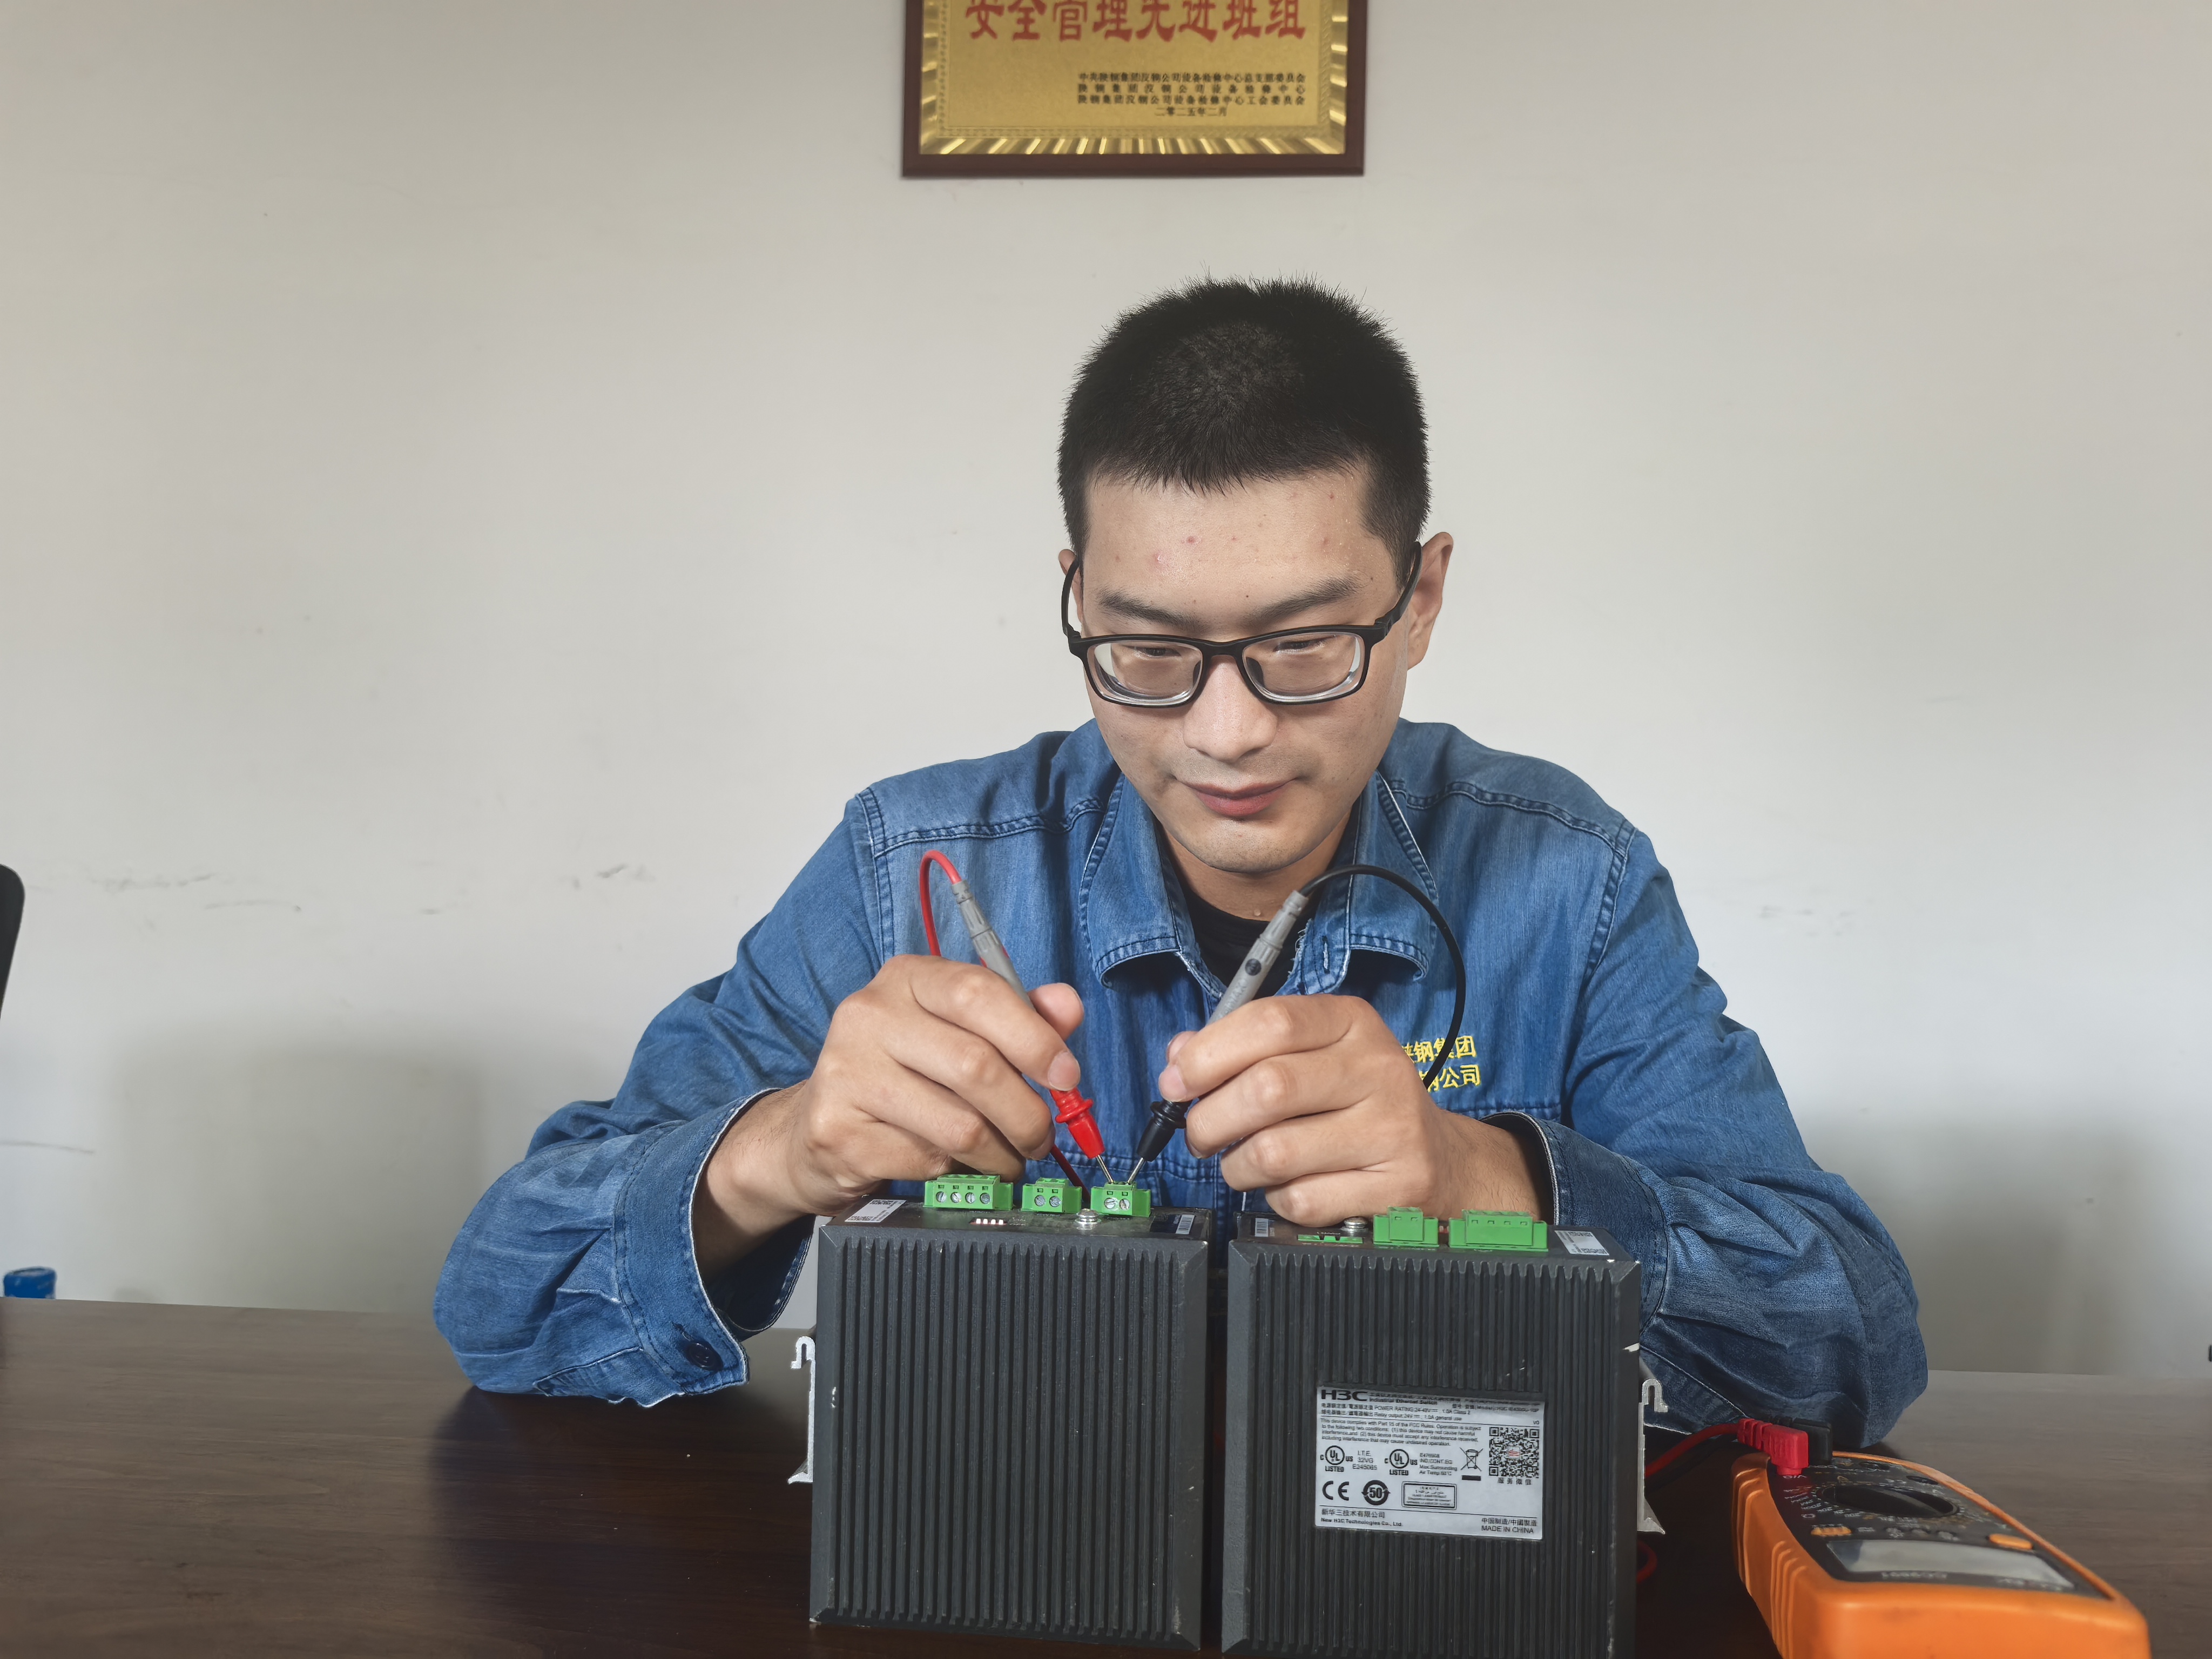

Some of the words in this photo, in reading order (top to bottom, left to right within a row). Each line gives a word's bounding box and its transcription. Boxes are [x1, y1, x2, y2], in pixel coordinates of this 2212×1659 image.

[965, 0, 1306, 43] 安全管理先进班组
[1321, 1390, 1368, 1401] H3C
[1322, 1480, 1350, 1501] CE
[1369, 1487, 1382, 1499] 50
[1321, 1508, 1385, 1519] 新华三技术有限公司
